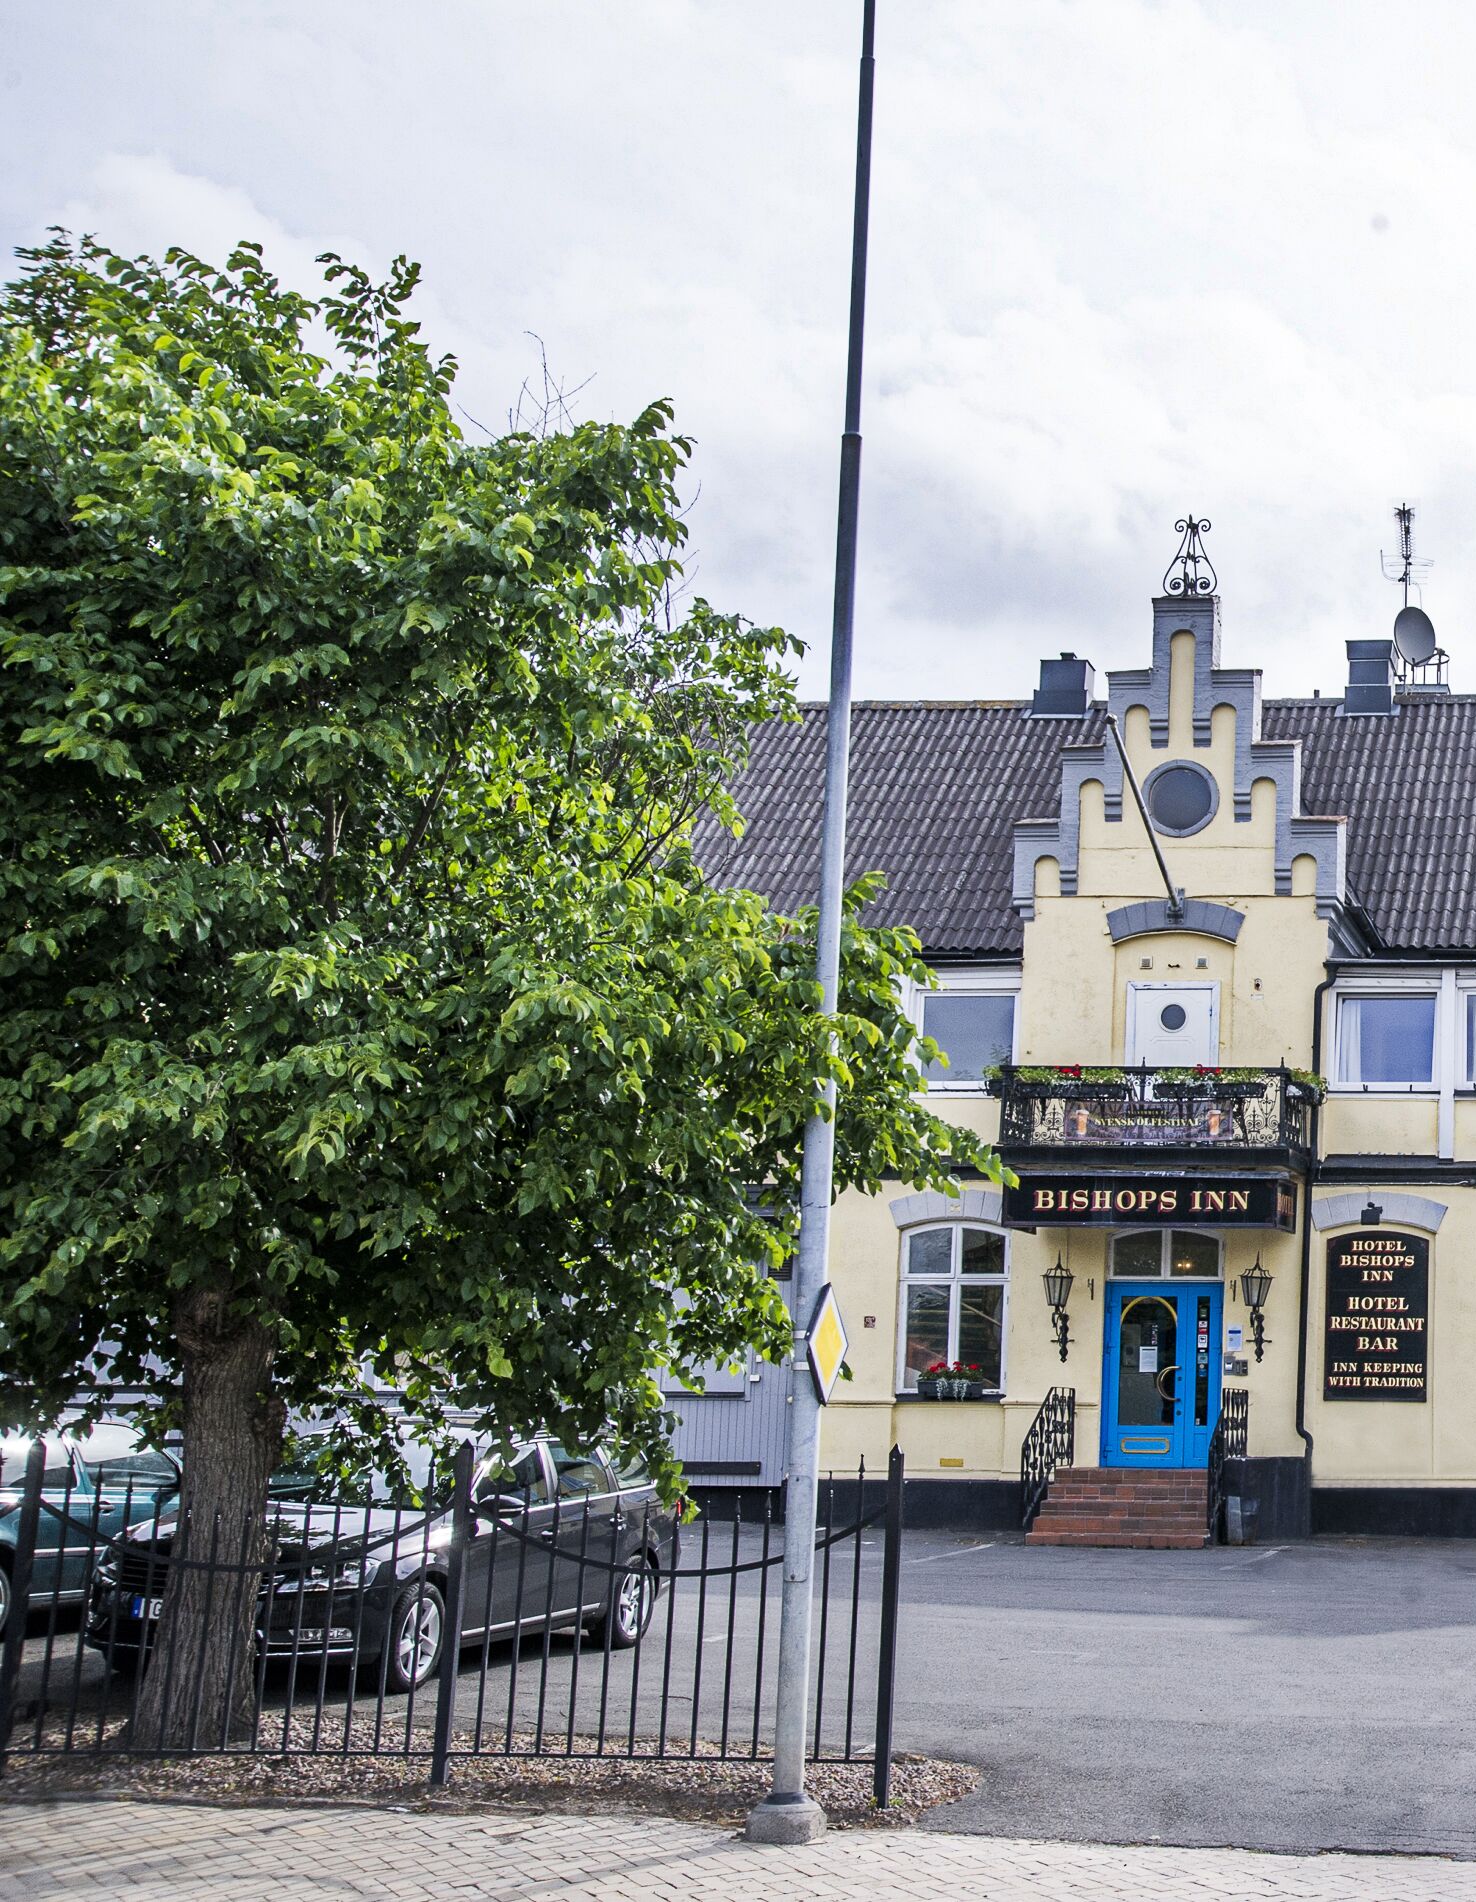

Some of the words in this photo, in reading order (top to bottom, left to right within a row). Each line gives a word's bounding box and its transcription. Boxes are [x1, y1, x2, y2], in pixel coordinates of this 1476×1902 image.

[1033, 1189, 1177, 1212] BISHOPS
[1190, 1190, 1250, 1211] INN
[1352, 1240, 1407, 1252] HOTEL
[1340, 1255, 1415, 1268] BISHOPS
[1361, 1270, 1394, 1282] INN
[1347, 1297, 1409, 1311] HOTEL
[1329, 1316, 1424, 1331] RESTAURANT
[1356, 1336, 1399, 1351] BAR
[1333, 1362, 1358, 1372] INN
[1363, 1362, 1423, 1373] KEEPING
[1328, 1376, 1361, 1387] WITH
[1364, 1377, 1424, 1388] TRADITION
